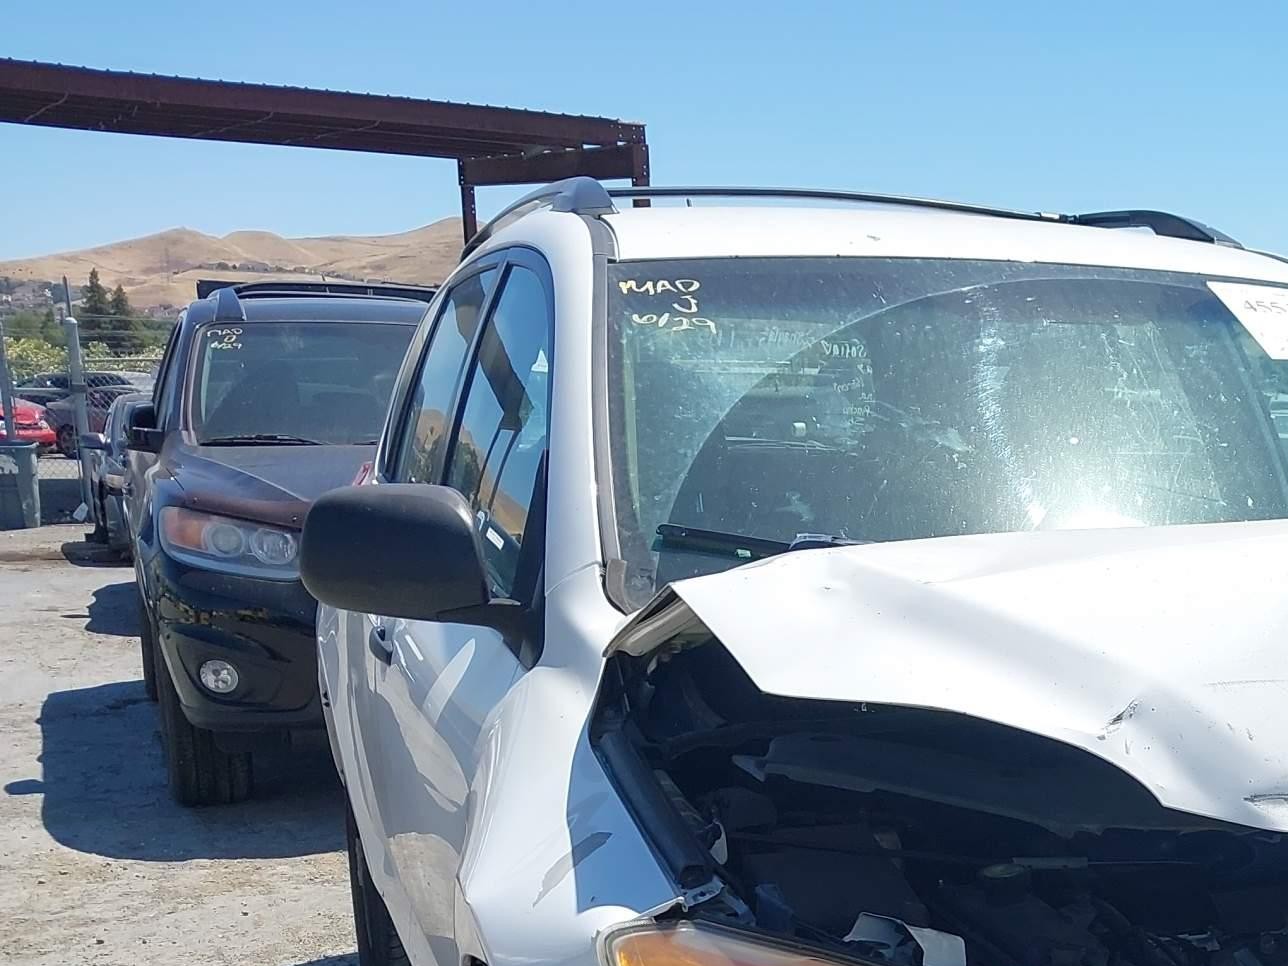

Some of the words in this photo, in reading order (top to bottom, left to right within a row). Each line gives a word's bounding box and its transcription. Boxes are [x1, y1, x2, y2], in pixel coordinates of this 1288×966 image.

[619, 279, 701, 296] MAD
[672, 295, 698, 313] J
[632, 312, 717, 335] 6/29
